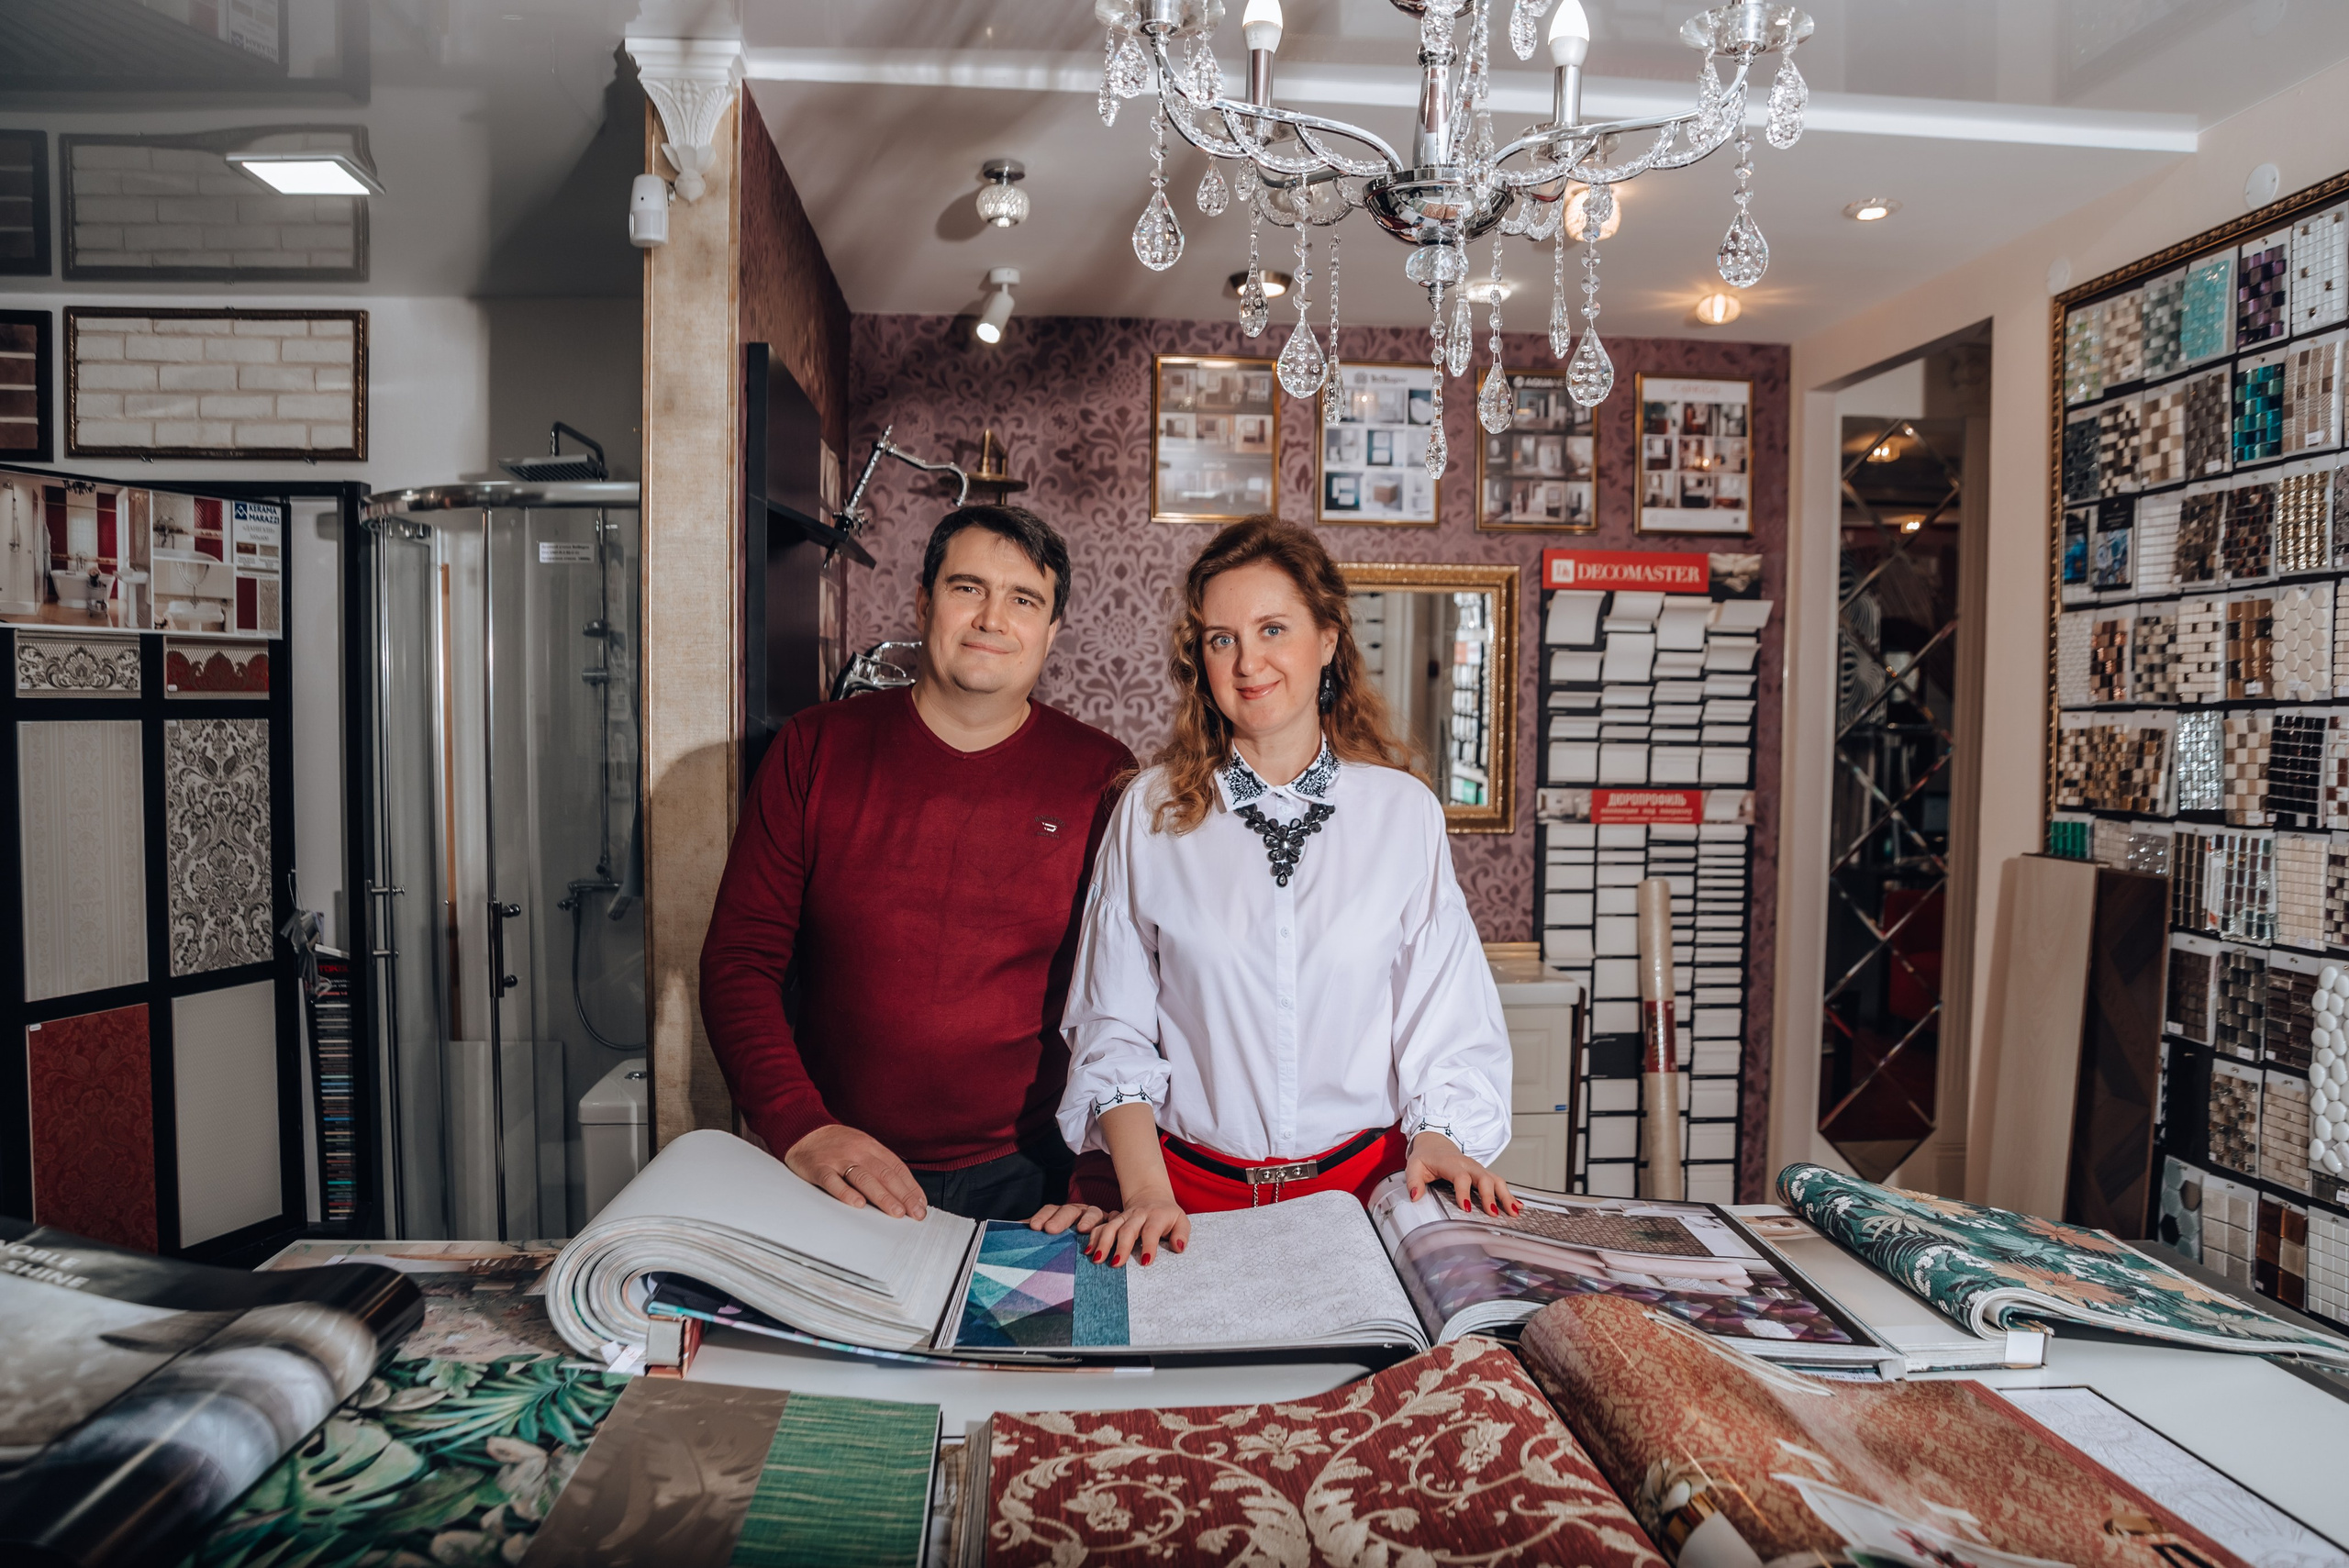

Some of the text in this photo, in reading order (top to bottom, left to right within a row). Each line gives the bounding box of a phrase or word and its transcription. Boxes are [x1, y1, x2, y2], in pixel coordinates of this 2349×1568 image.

[1525, 377, 1565, 387] AQUANE
[249, 503, 277, 515] KERAMA
[249, 514, 280, 524] MARAZZI
[1577, 562, 1700, 584] DECOMASTER
[1, 1259, 91, 1289] SHINE
